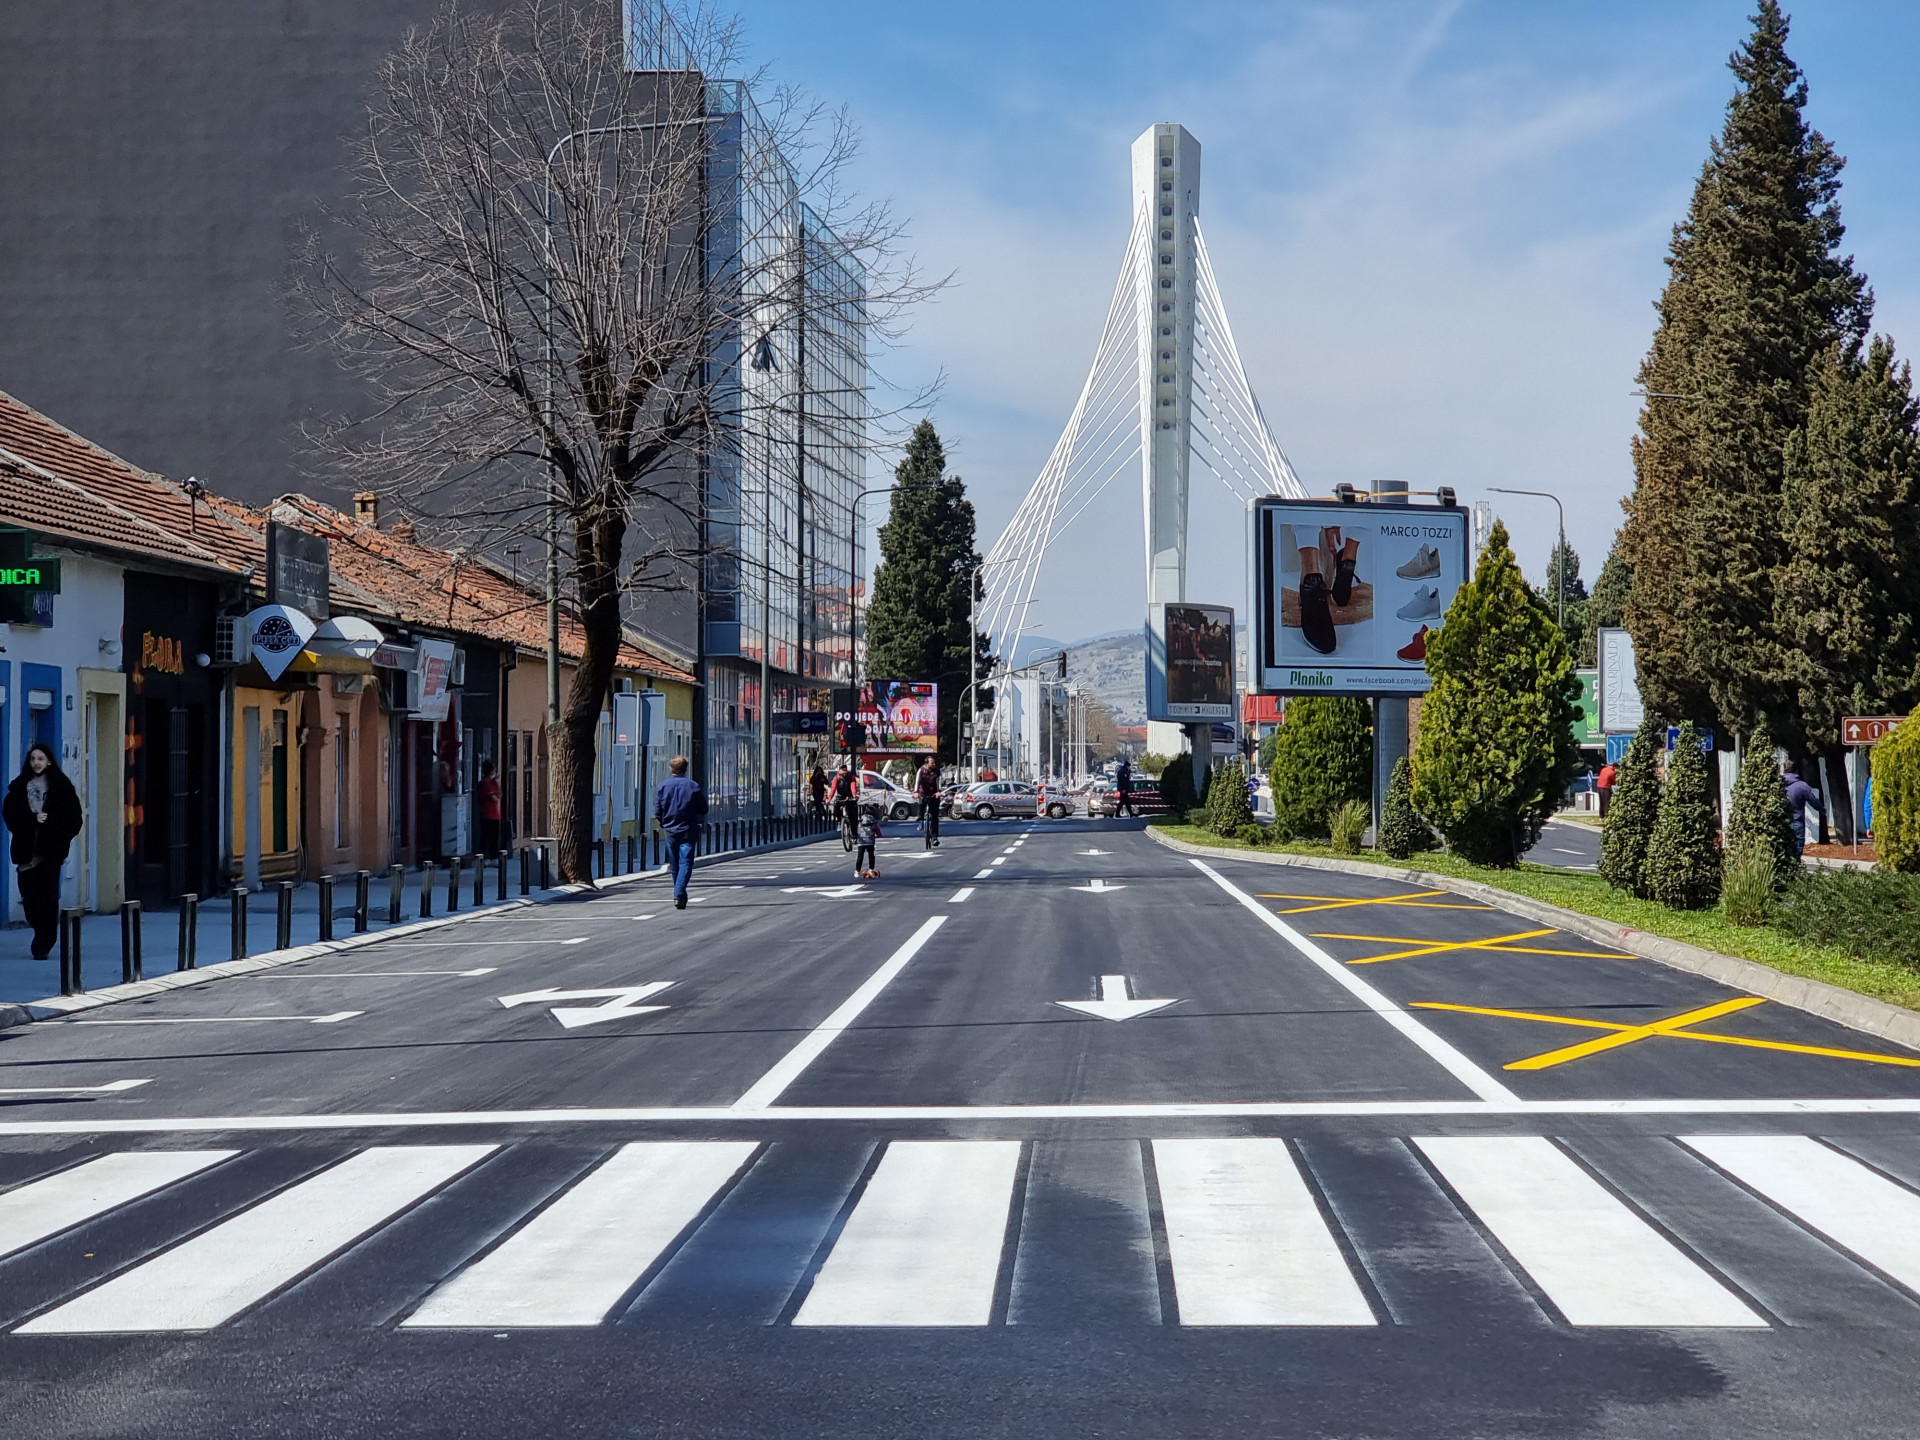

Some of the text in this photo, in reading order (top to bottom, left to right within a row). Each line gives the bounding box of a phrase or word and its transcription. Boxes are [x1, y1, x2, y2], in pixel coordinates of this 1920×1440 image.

[1380, 525, 1452, 539] MARCO TOZZI
[281, 635, 298, 645] CUT
[1290, 670, 1333, 686] Planika
[1607, 637, 1618, 724] MARINA RINALDI
[897, 725, 924, 735] DANA
[1873, 724, 1879, 737] 1
